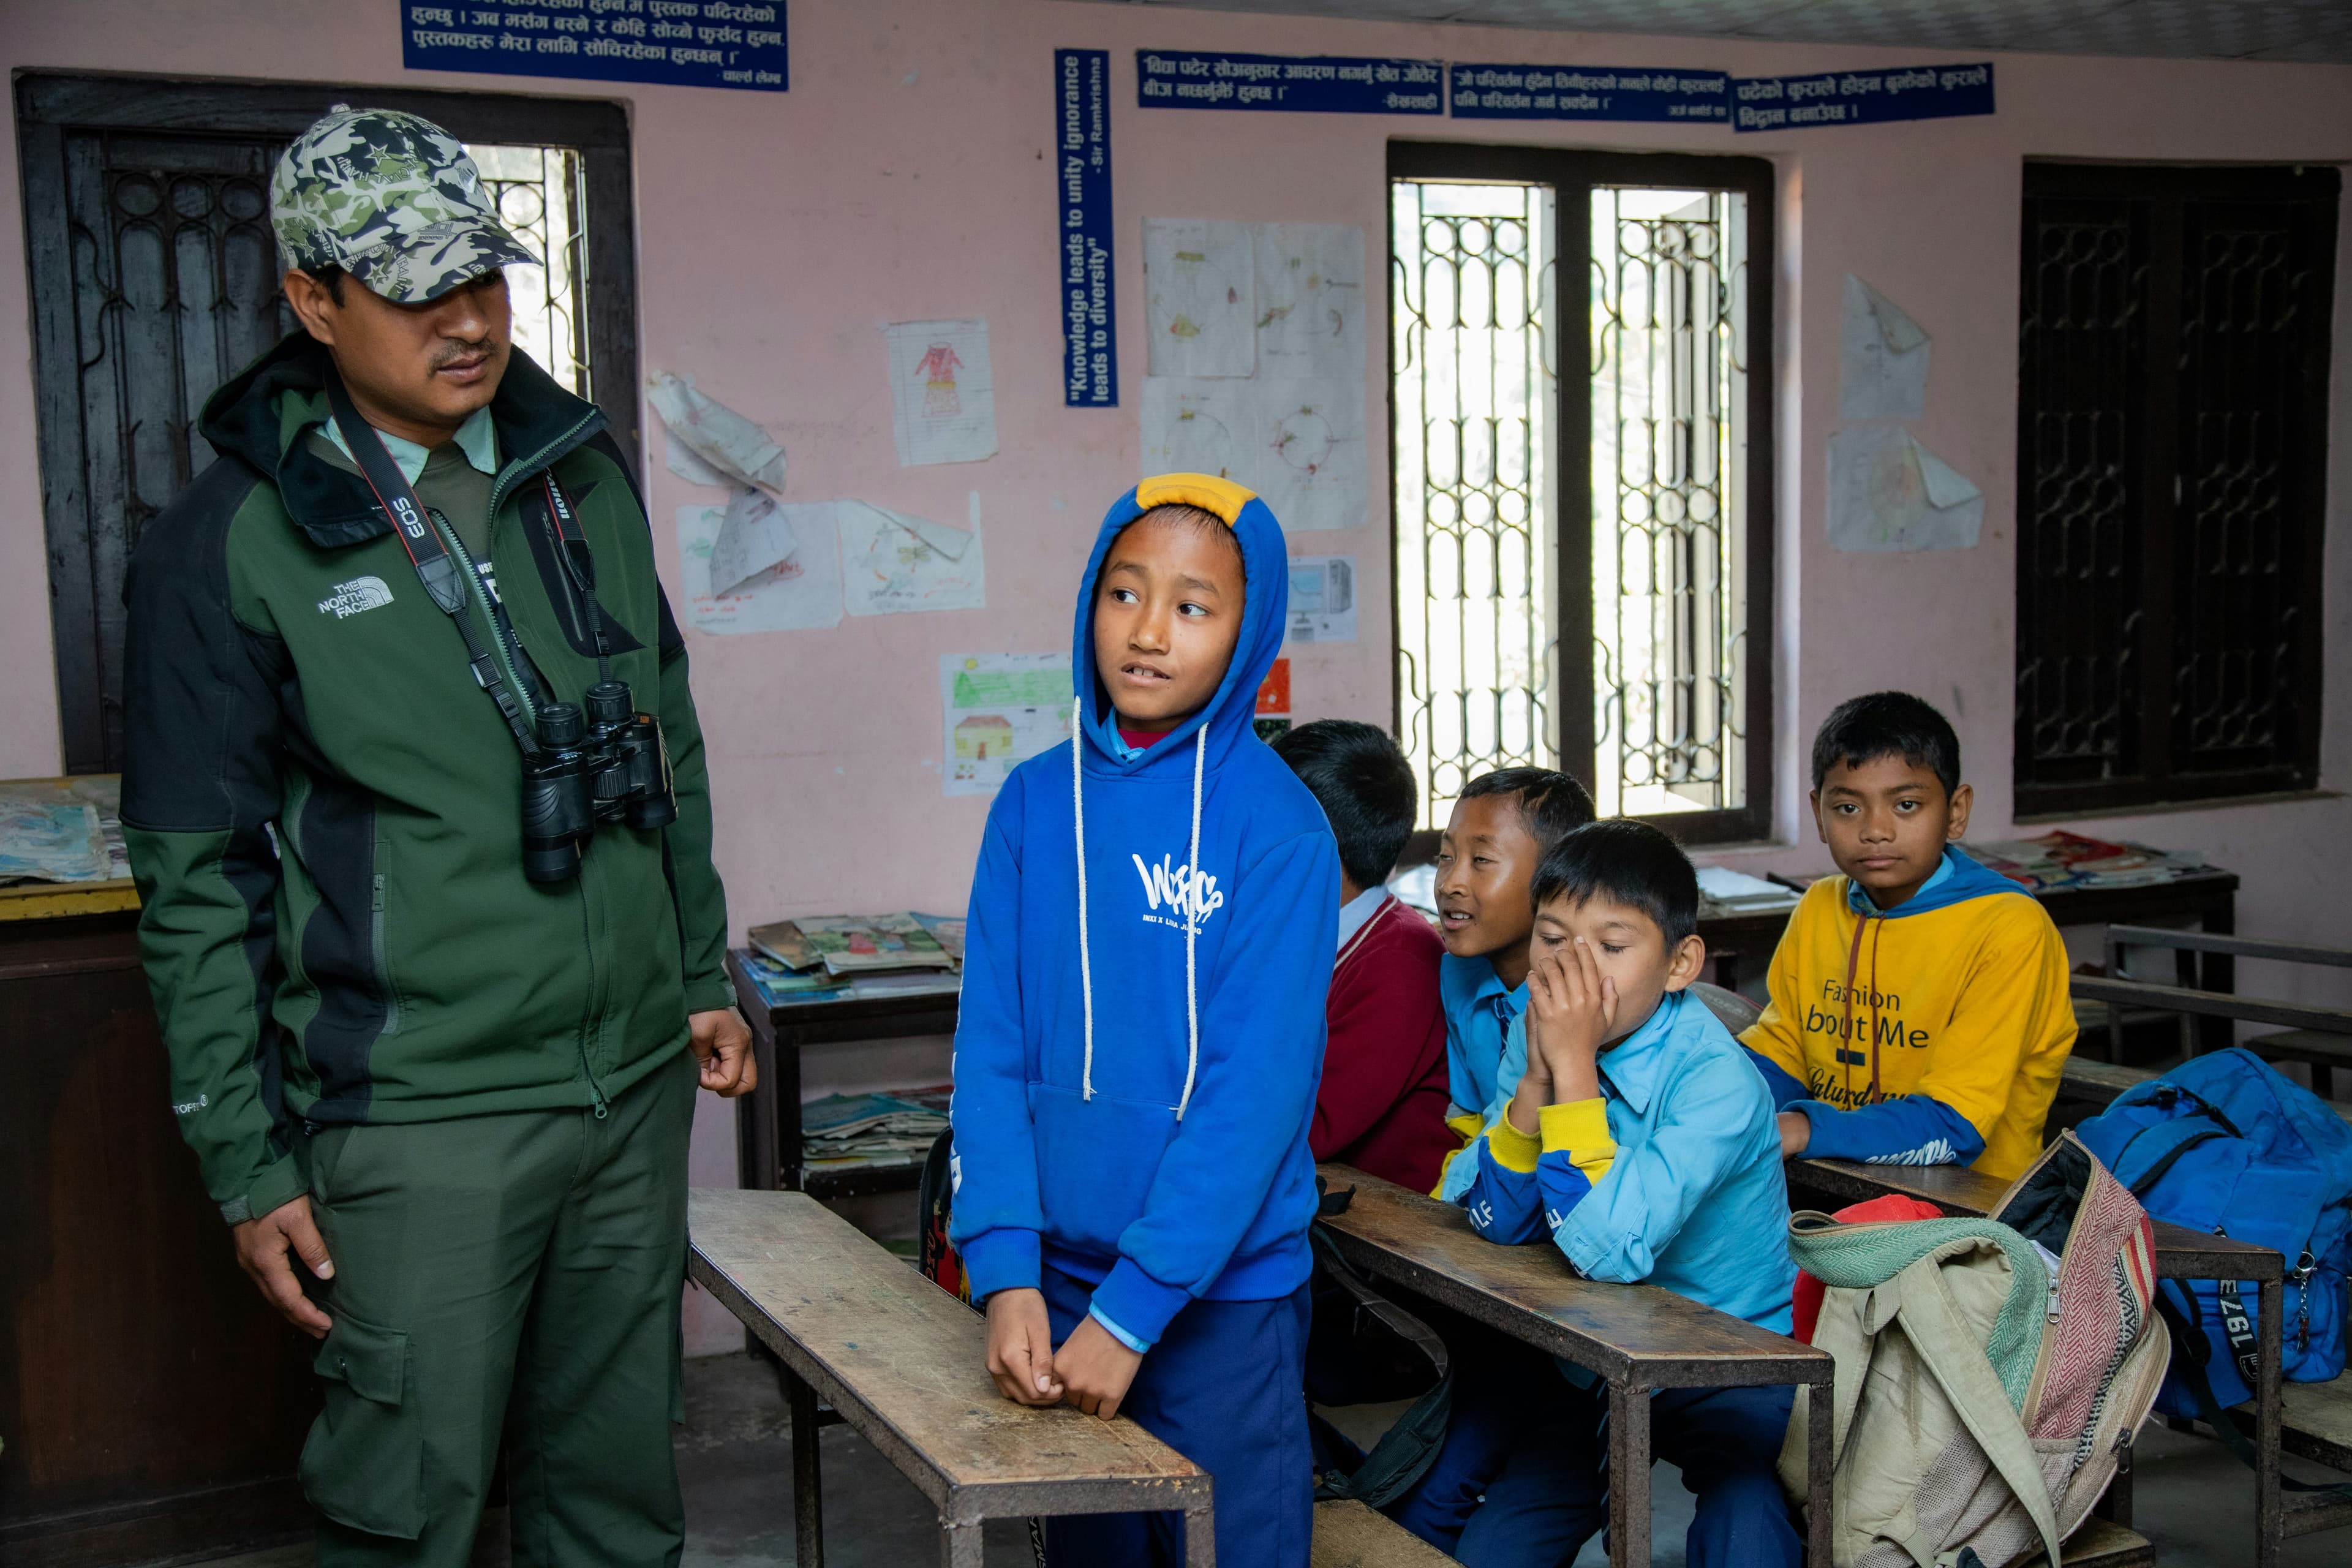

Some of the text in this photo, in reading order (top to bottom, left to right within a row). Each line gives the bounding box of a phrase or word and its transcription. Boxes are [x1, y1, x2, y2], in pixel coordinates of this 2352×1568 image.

[1090, 57, 1103, 143] Ramkrishna
[1090, 146, 1104, 167] Sir
[1064, 55, 1090, 401] "Knowledge leads to unity ignorance
[1087, 237, 1109, 402] leads to diversity"
[393, 497, 425, 538] EOS
[318, 590, 366, 614] NORTH
[333, 581, 360, 595] THE
[335, 601, 369, 619] FACE
[1823, 979, 1901, 1012] Fashion
[1799, 1003, 1930, 1049] bout Me
